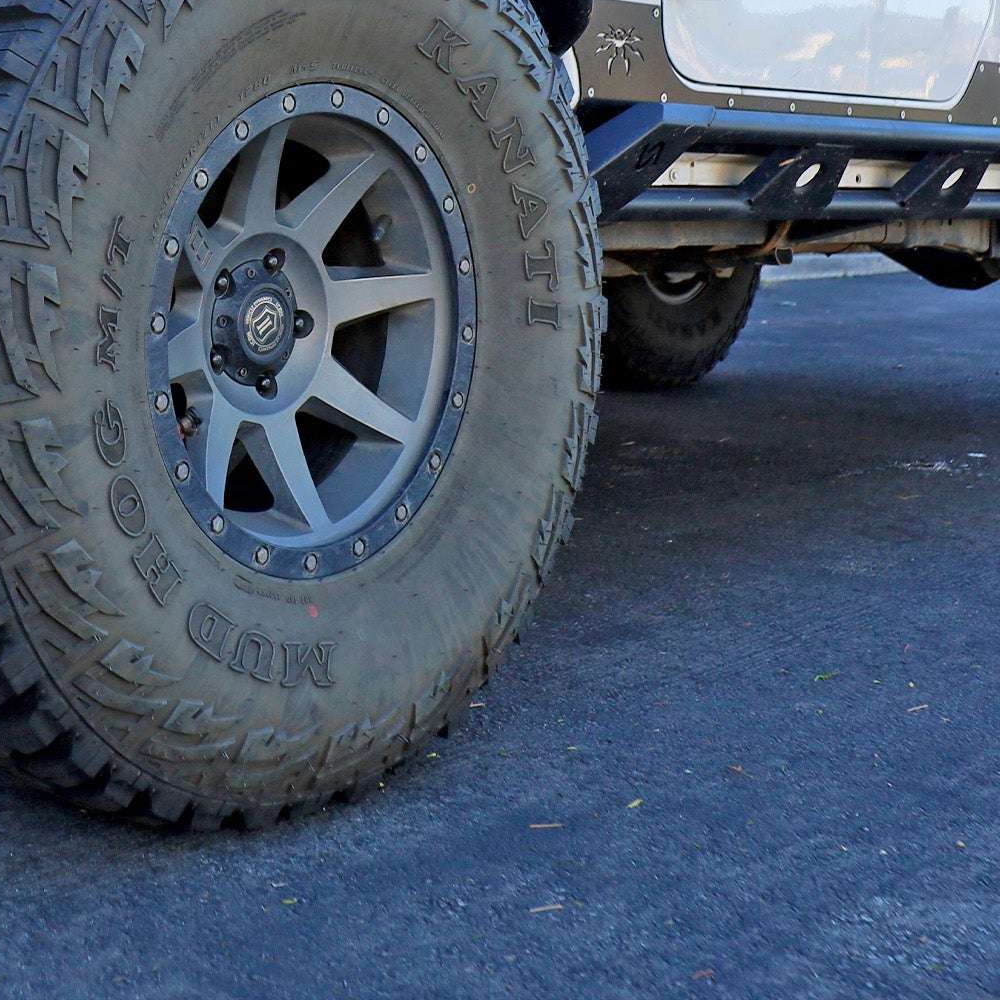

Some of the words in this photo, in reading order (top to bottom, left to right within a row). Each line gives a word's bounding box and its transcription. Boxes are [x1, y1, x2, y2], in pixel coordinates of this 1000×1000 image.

[416, 16, 562, 330] KANATI
[96, 214, 136, 374] M/T
[94, 398, 184, 607] HOG
[188, 601, 339, 688] MUD
